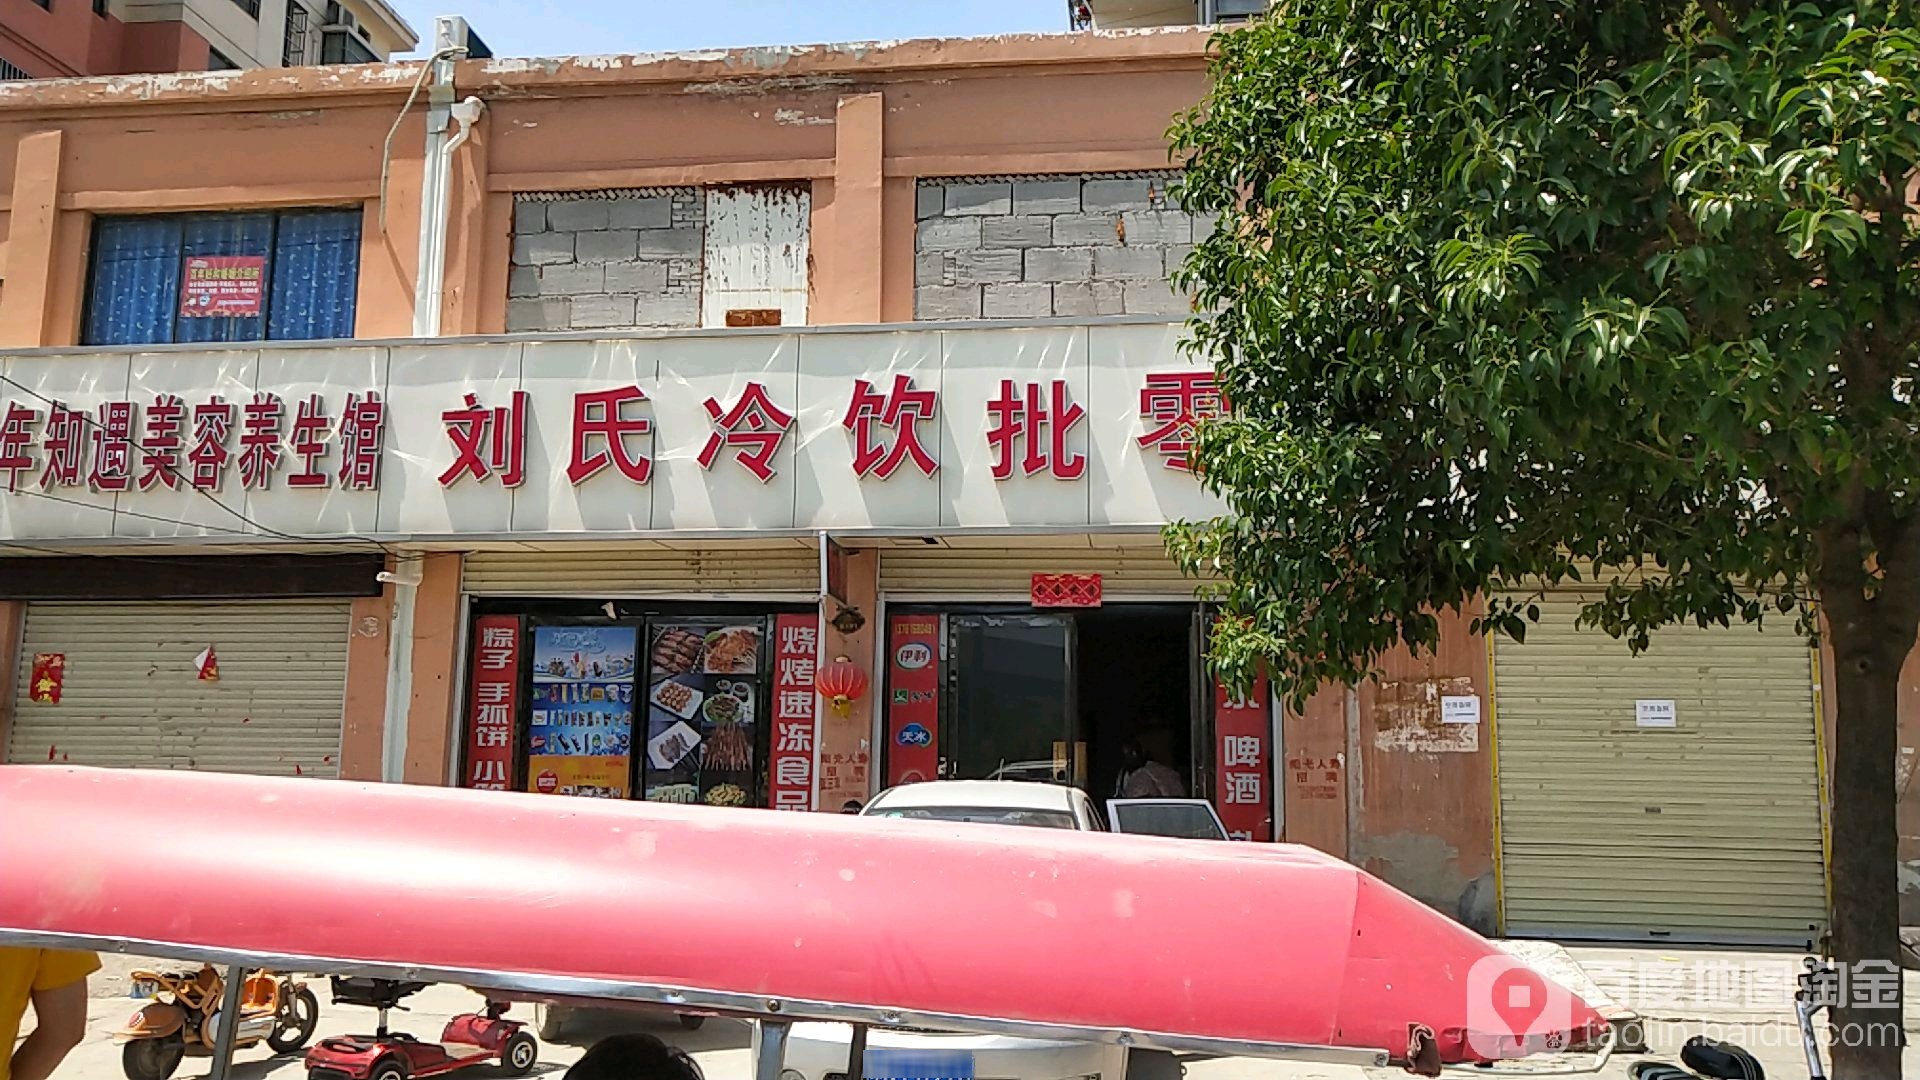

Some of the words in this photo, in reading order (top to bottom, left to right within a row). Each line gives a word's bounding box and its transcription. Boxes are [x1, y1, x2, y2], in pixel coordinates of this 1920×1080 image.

[0, 391, 386, 493] 年知遇美容养生馆
[437, 371, 1231, 489] 刘氏冷饮批零
[480, 627, 514, 669] 粽子
[475, 682, 510, 747] 手抓饼
[473, 761, 506, 789] 小
[1223, 735, 1261, 805] 啤酒
